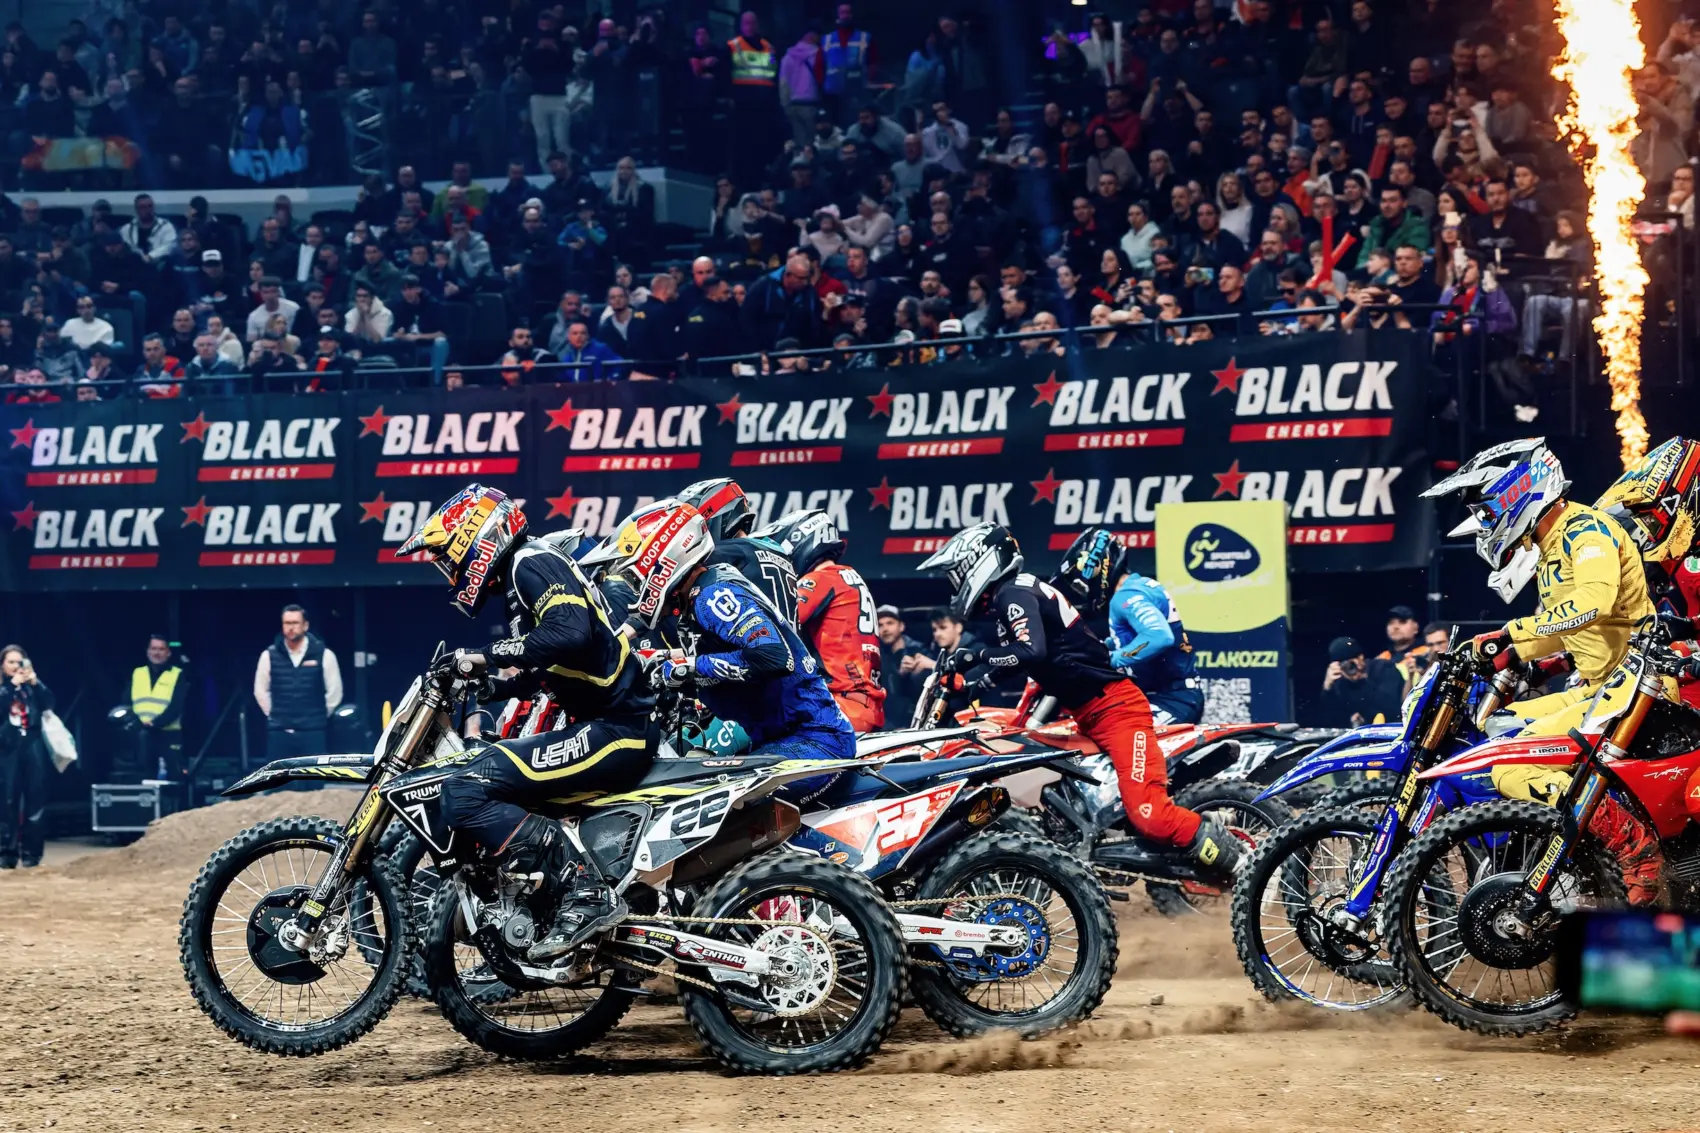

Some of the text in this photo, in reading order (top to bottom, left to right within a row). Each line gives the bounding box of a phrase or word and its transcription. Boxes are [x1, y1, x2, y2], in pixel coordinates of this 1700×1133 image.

[1049, 372, 1191, 426] BLACK
[1235, 361, 1398, 416] BLACK
[570, 405, 707, 450] BLACK
[736, 397, 853, 444] BLACK
[886, 386, 1015, 437] BLACK
[33, 424, 163, 466] BLACK
[203, 417, 341, 460] BLACK
[382, 411, 525, 455] BLACK
[1078, 433, 1148, 448] ENERGY
[1266, 423, 1343, 440] ENERGY
[600, 457, 672, 469] ENERGY
[759, 450, 813, 464] ENERGY
[907, 442, 970, 457] ENERGY
[57, 471, 123, 485] ENERGY
[230, 466, 299, 480] ENERGY
[411, 463, 480, 475] ENERGY
[1497, 460, 1551, 511] 100%
[890, 482, 1014, 531] BLACK
[35, 507, 165, 548] BLACK
[204, 502, 342, 545] BLACK
[452, 510, 485, 557] LEATT
[1293, 529, 1347, 543] ERGY
[682, 532, 695, 549] BELL
[61, 555, 125, 568] ENERGY
[232, 552, 300, 565] ENERGY
[955, 541, 987, 578] 100%
[1536, 608, 1599, 636] PROGRESSIVE
[988, 654, 1019, 667] AMPED
[1194, 650, 1279, 668] TLAKOZZ!
[1131, 731, 1147, 783] AMPED
[670, 790, 730, 838] 22
[648, 931, 676, 943] EXCEL
